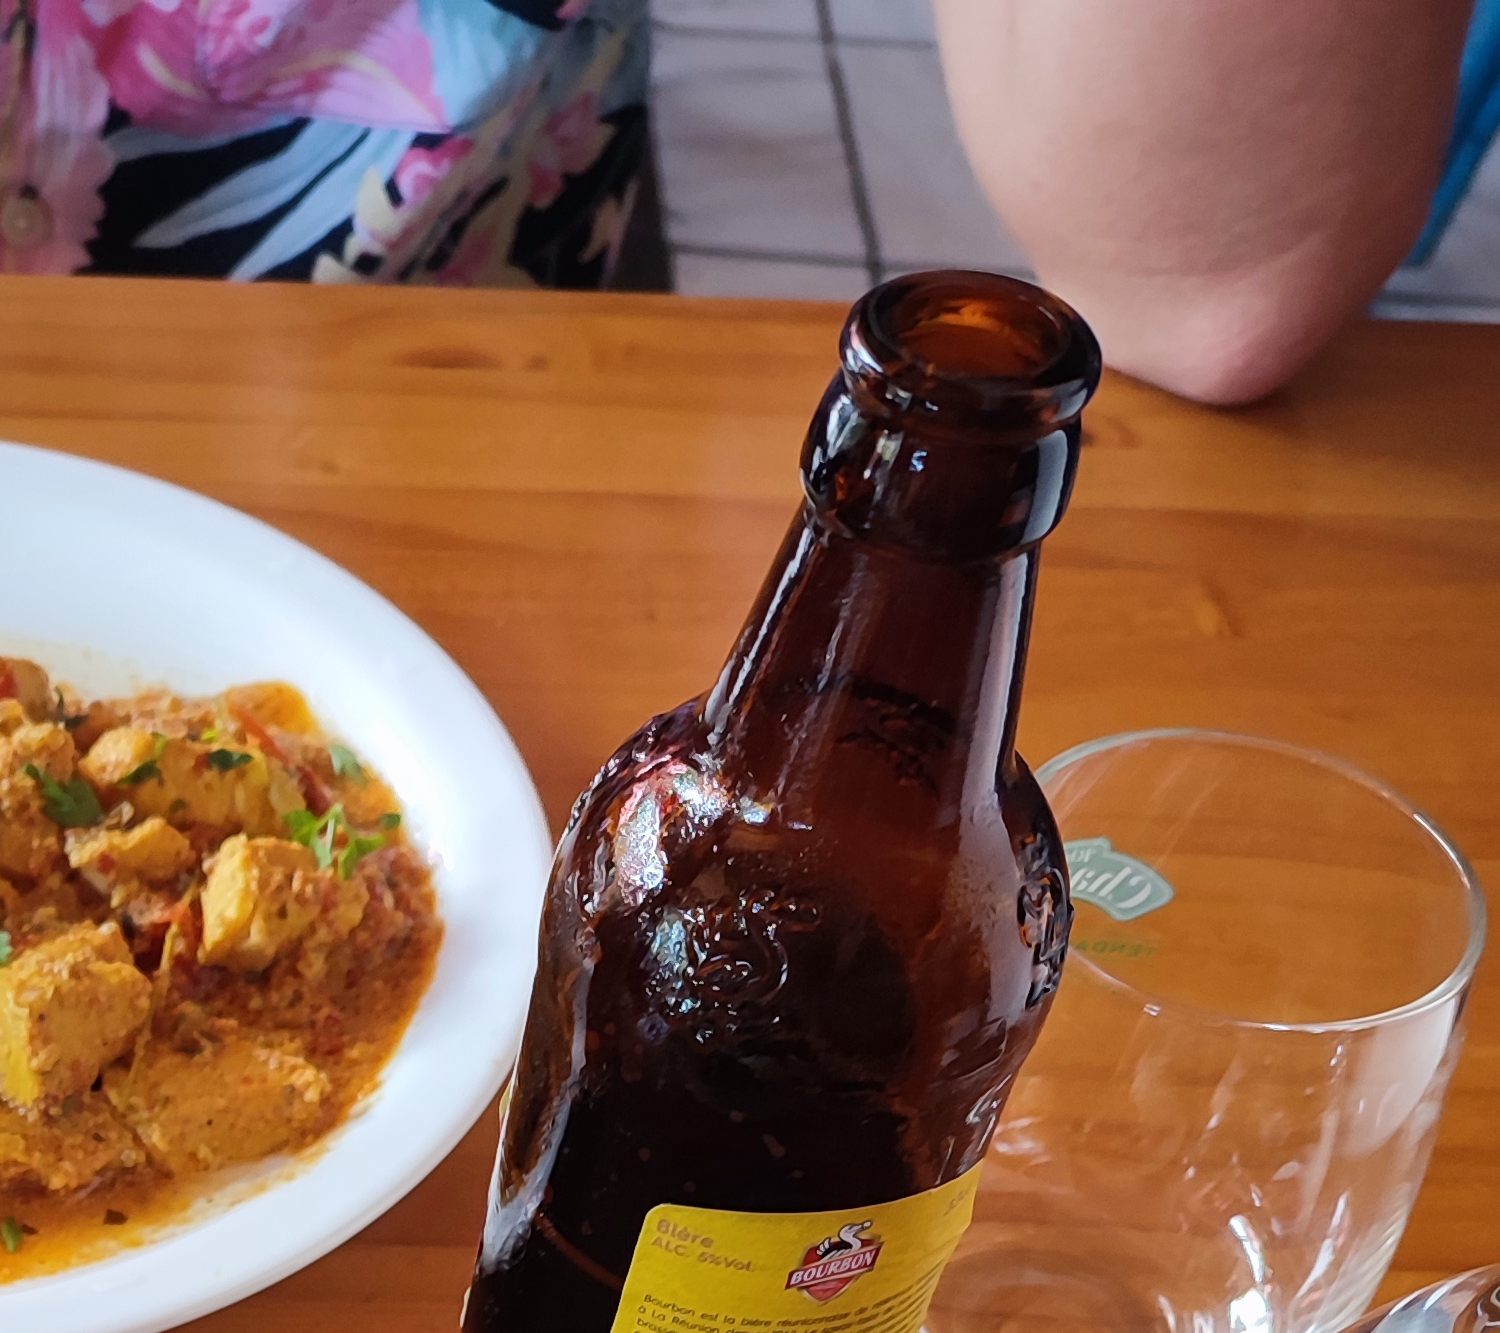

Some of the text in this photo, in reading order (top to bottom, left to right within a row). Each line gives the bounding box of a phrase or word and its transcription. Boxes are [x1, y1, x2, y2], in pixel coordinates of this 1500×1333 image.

[789, 1249, 876, 1286] BOURBON
[643, 1294, 695, 1316] Bourbon
[700, 1312, 719, 1322] est
[723, 1315, 736, 1325] la
[741, 1317, 772, 1327] bière
